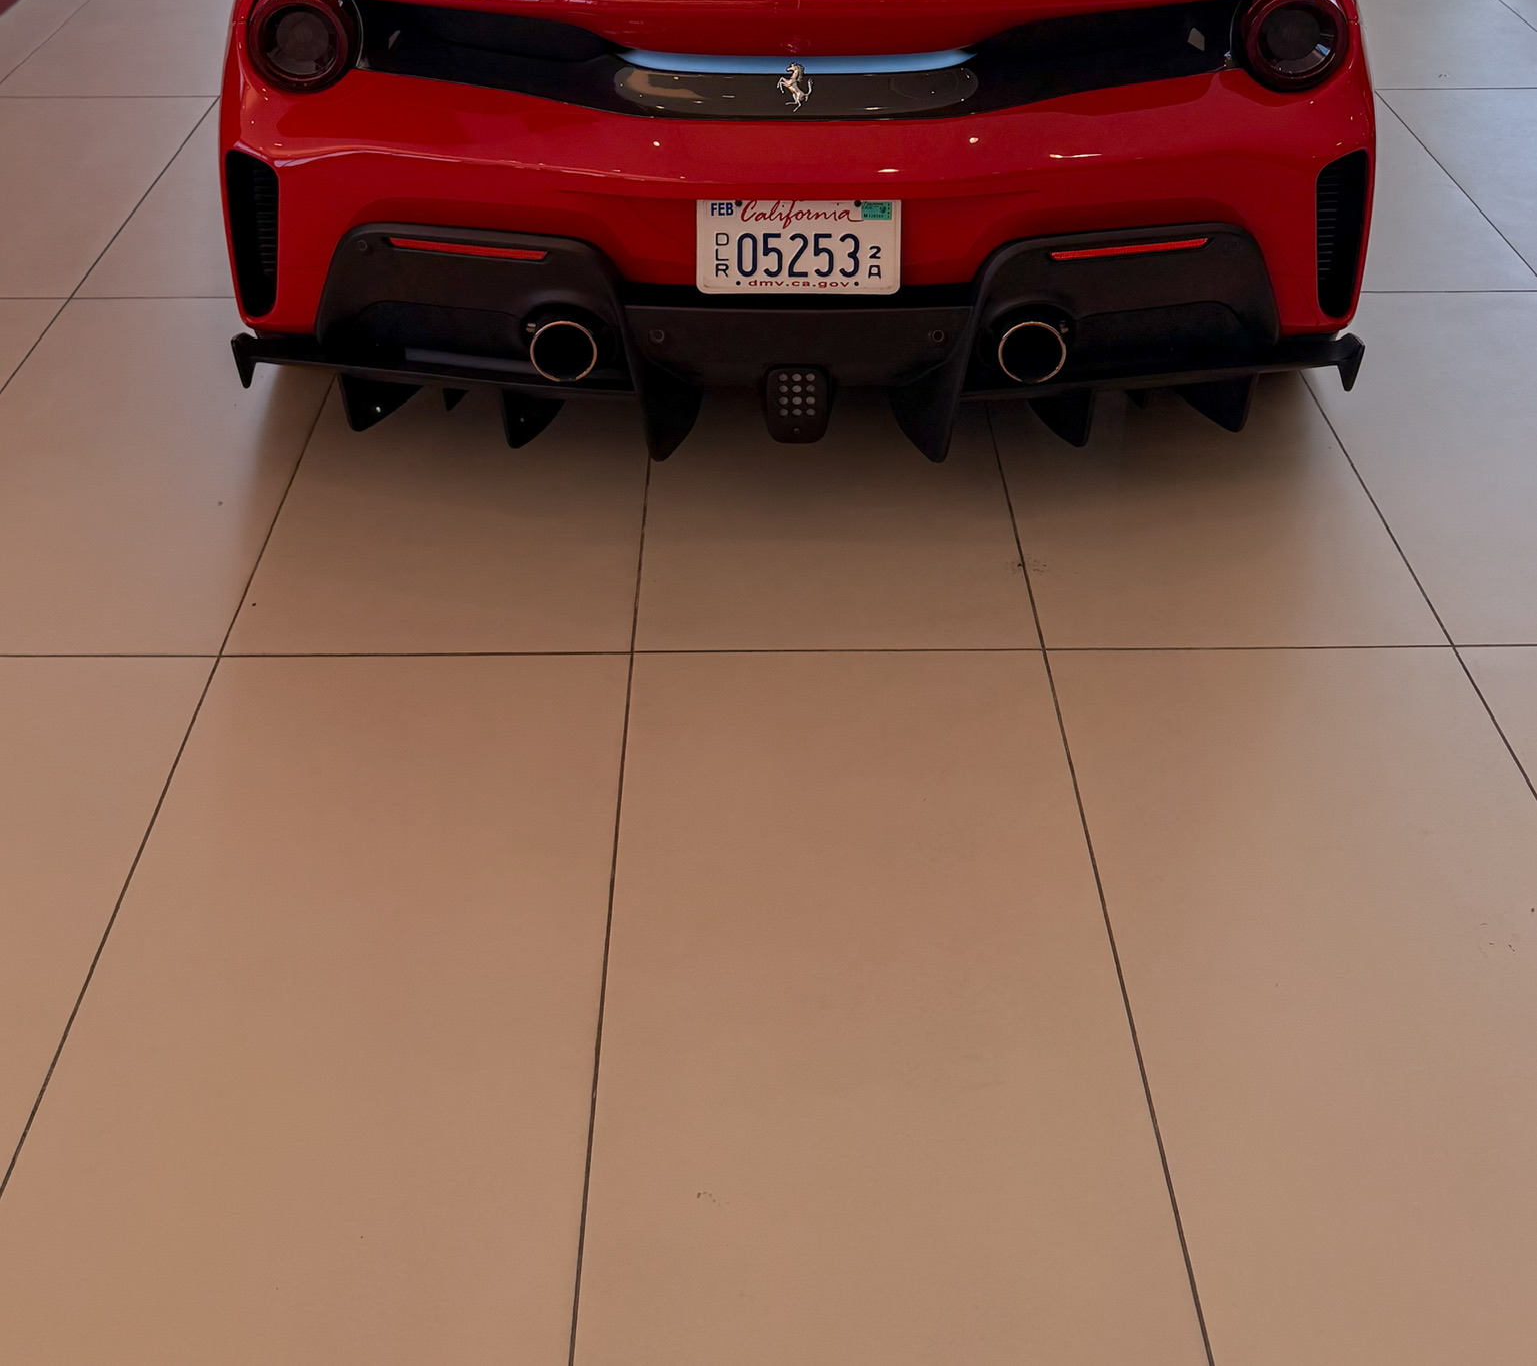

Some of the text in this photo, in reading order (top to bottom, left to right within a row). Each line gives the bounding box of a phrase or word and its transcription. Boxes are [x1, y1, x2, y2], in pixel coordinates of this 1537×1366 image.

[710, 202, 734, 217] FEB
[740, 200, 864, 229] California
[737, 232, 860, 278] 05253
[748, 279, 850, 289] dmv.ca.gov
